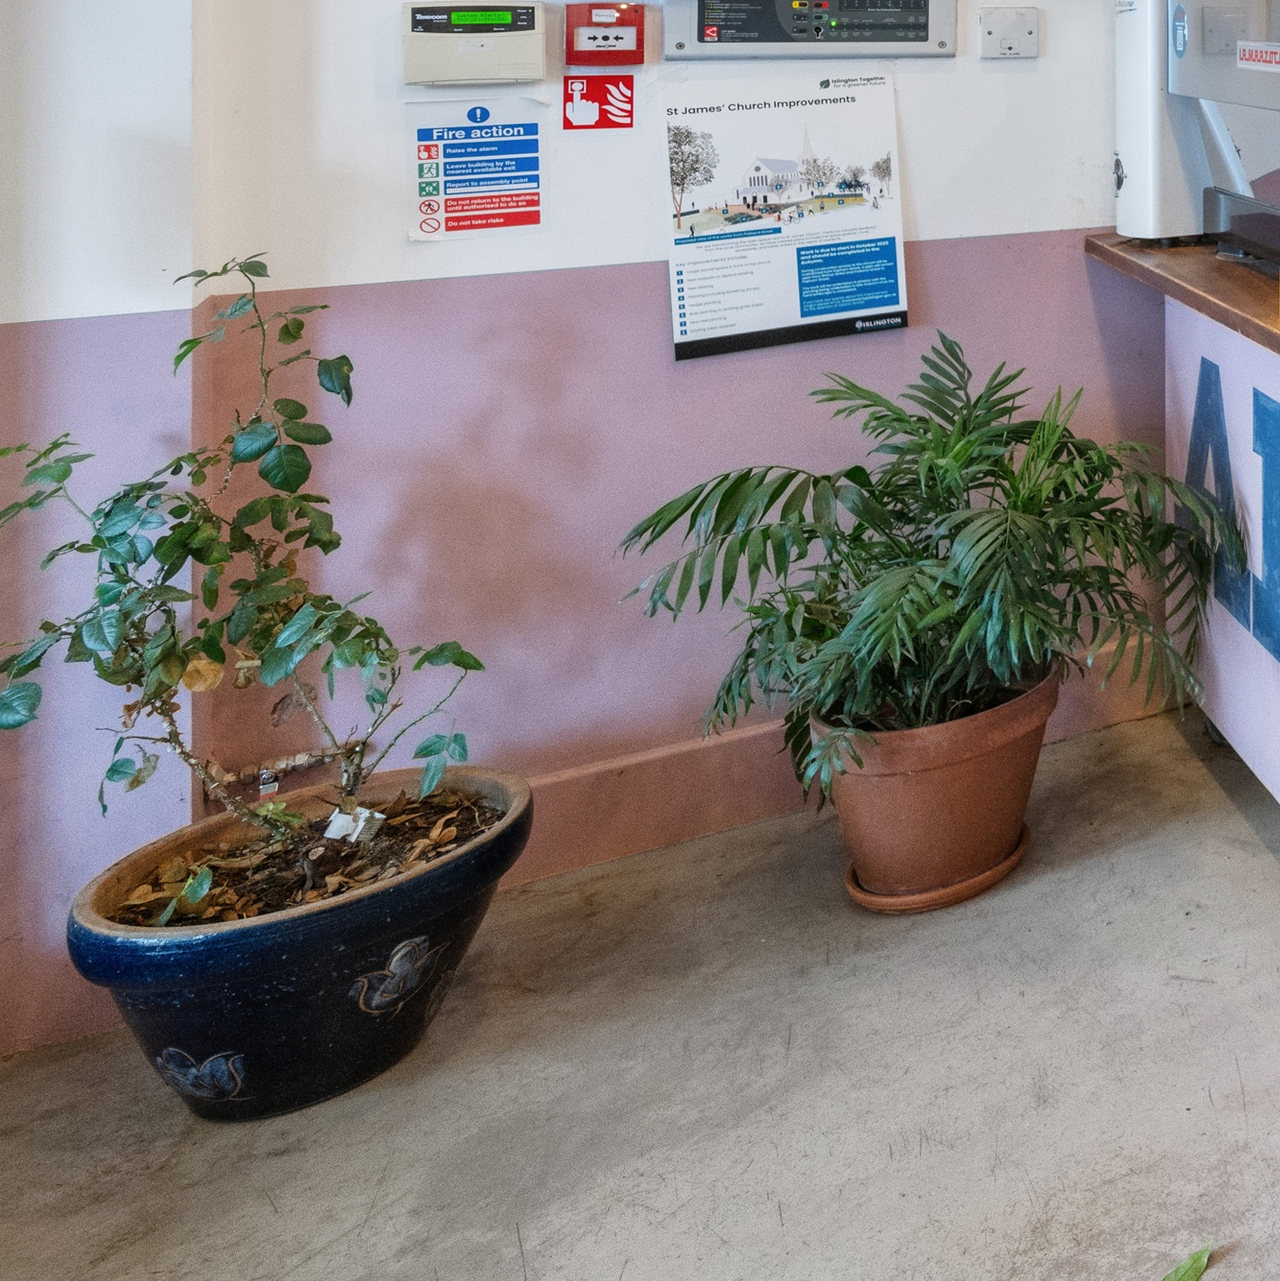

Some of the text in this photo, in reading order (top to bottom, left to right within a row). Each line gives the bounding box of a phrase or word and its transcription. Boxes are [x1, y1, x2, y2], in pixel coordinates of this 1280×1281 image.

[666, 107, 678, 116] St
[728, 100, 771, 111] Church
[773, 95, 856, 109] Improvements
[432, 126, 524, 139] Fire action
